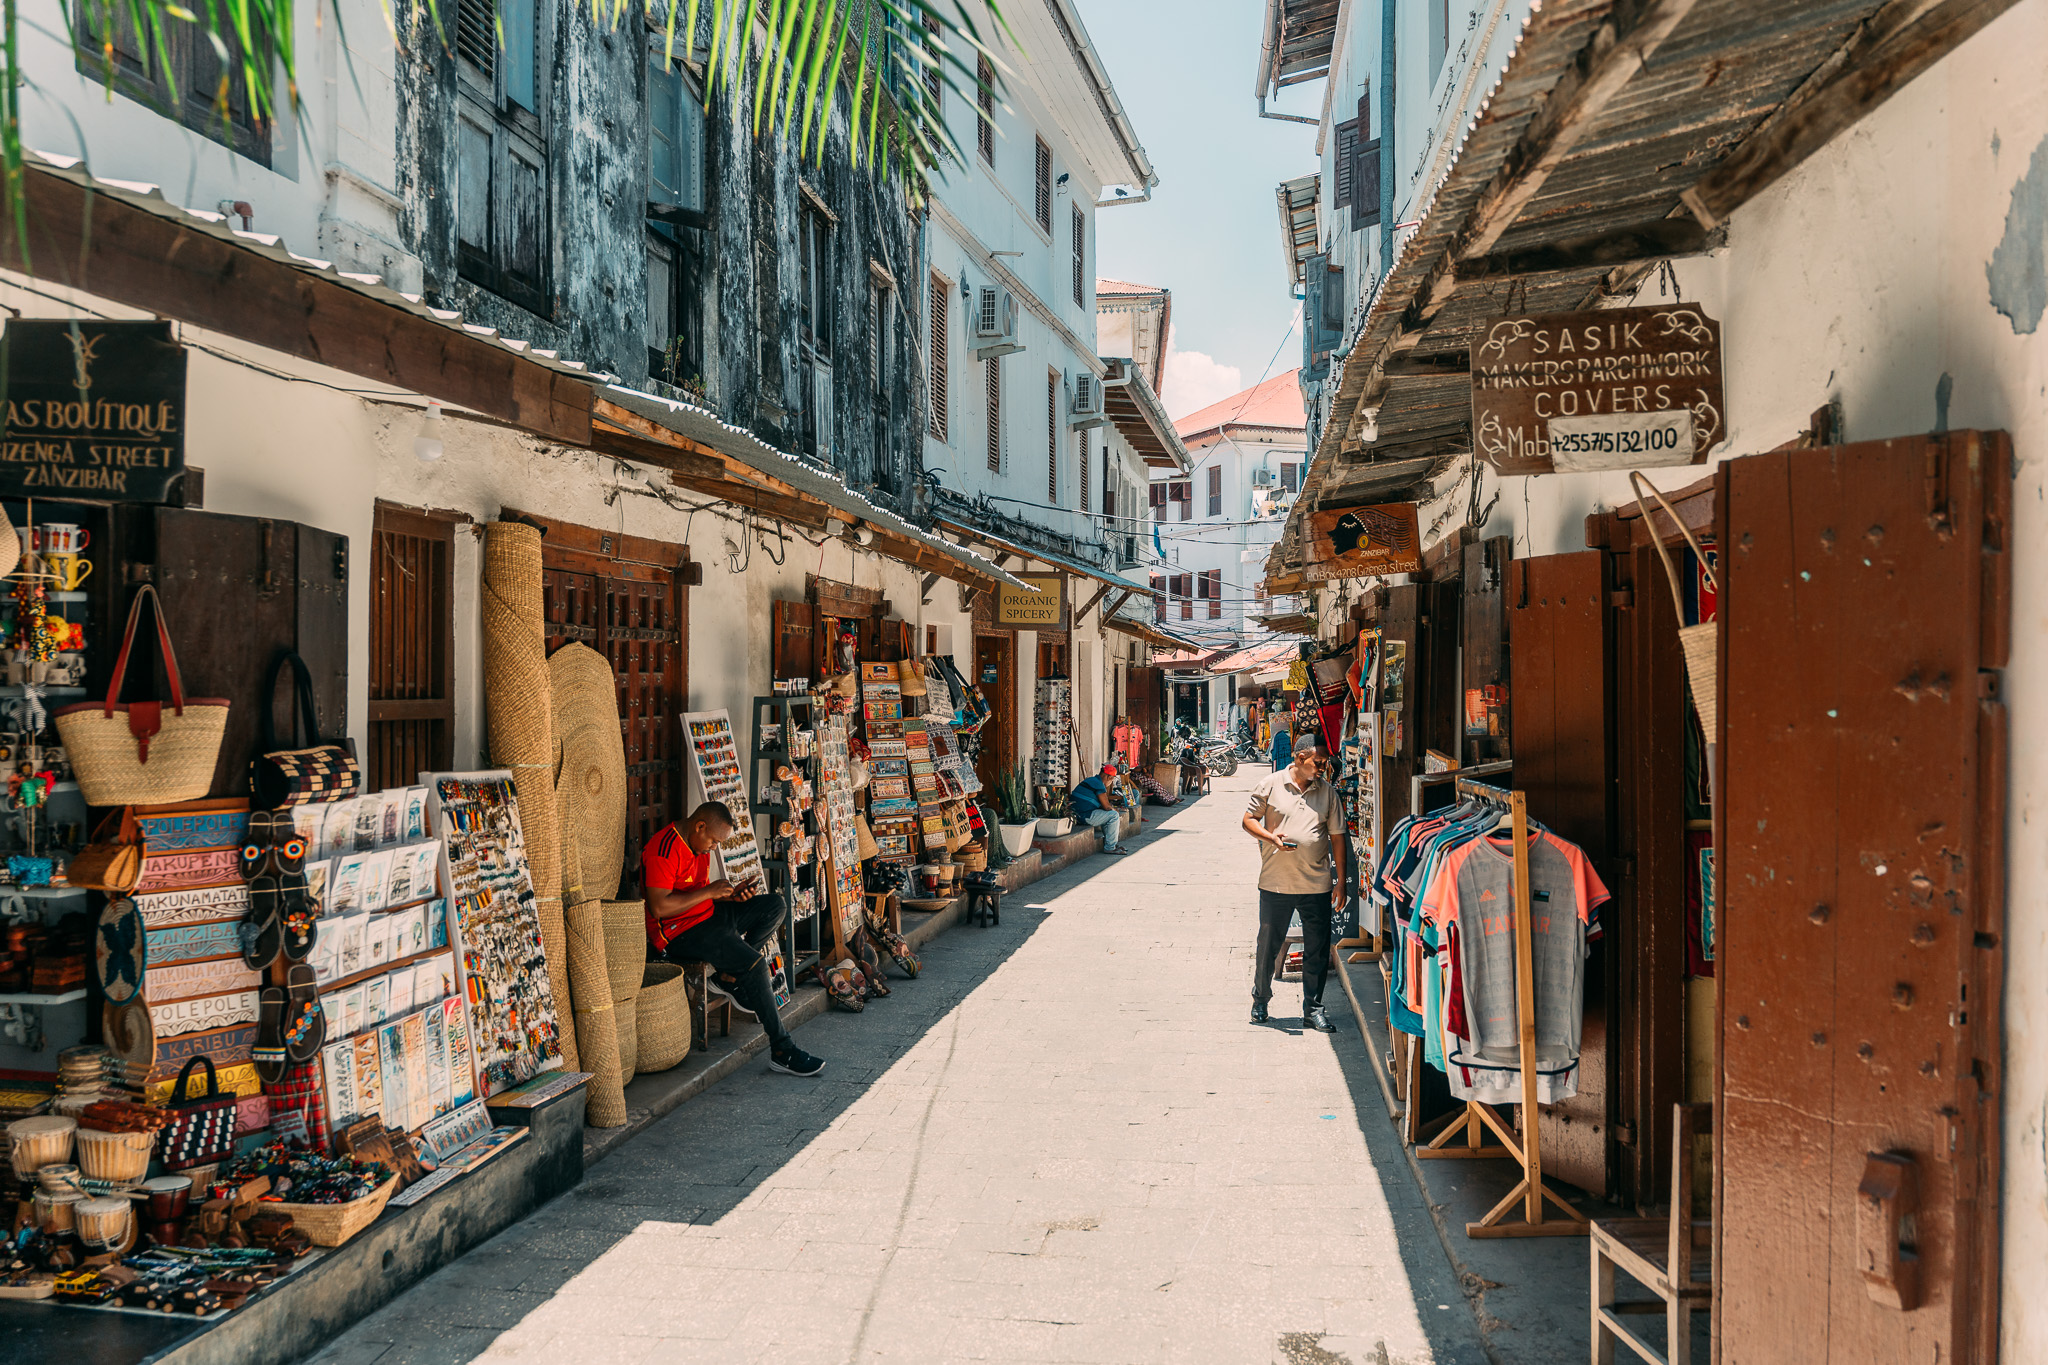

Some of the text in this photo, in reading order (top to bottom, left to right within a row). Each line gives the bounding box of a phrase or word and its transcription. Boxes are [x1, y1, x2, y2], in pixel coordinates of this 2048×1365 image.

[1533, 322, 1643, 354] SASIK
[1480, 360, 1574, 390] MAKERS
[1534, 385, 1671, 418] COVERS
[45, 397, 177, 437] BOUTIQUE
[0, 440, 174, 470] IZENGA STREET
[1507, 424, 1549, 458] Mob
[23, 463, 127, 493] ZANZIBAR
[1003, 595, 1058, 606] ORGANIC
[1006, 609, 1054, 619] SPICERY
[1483, 912, 1551, 936] ZANZAR
[169, 1032, 235, 1057] KARIBU
